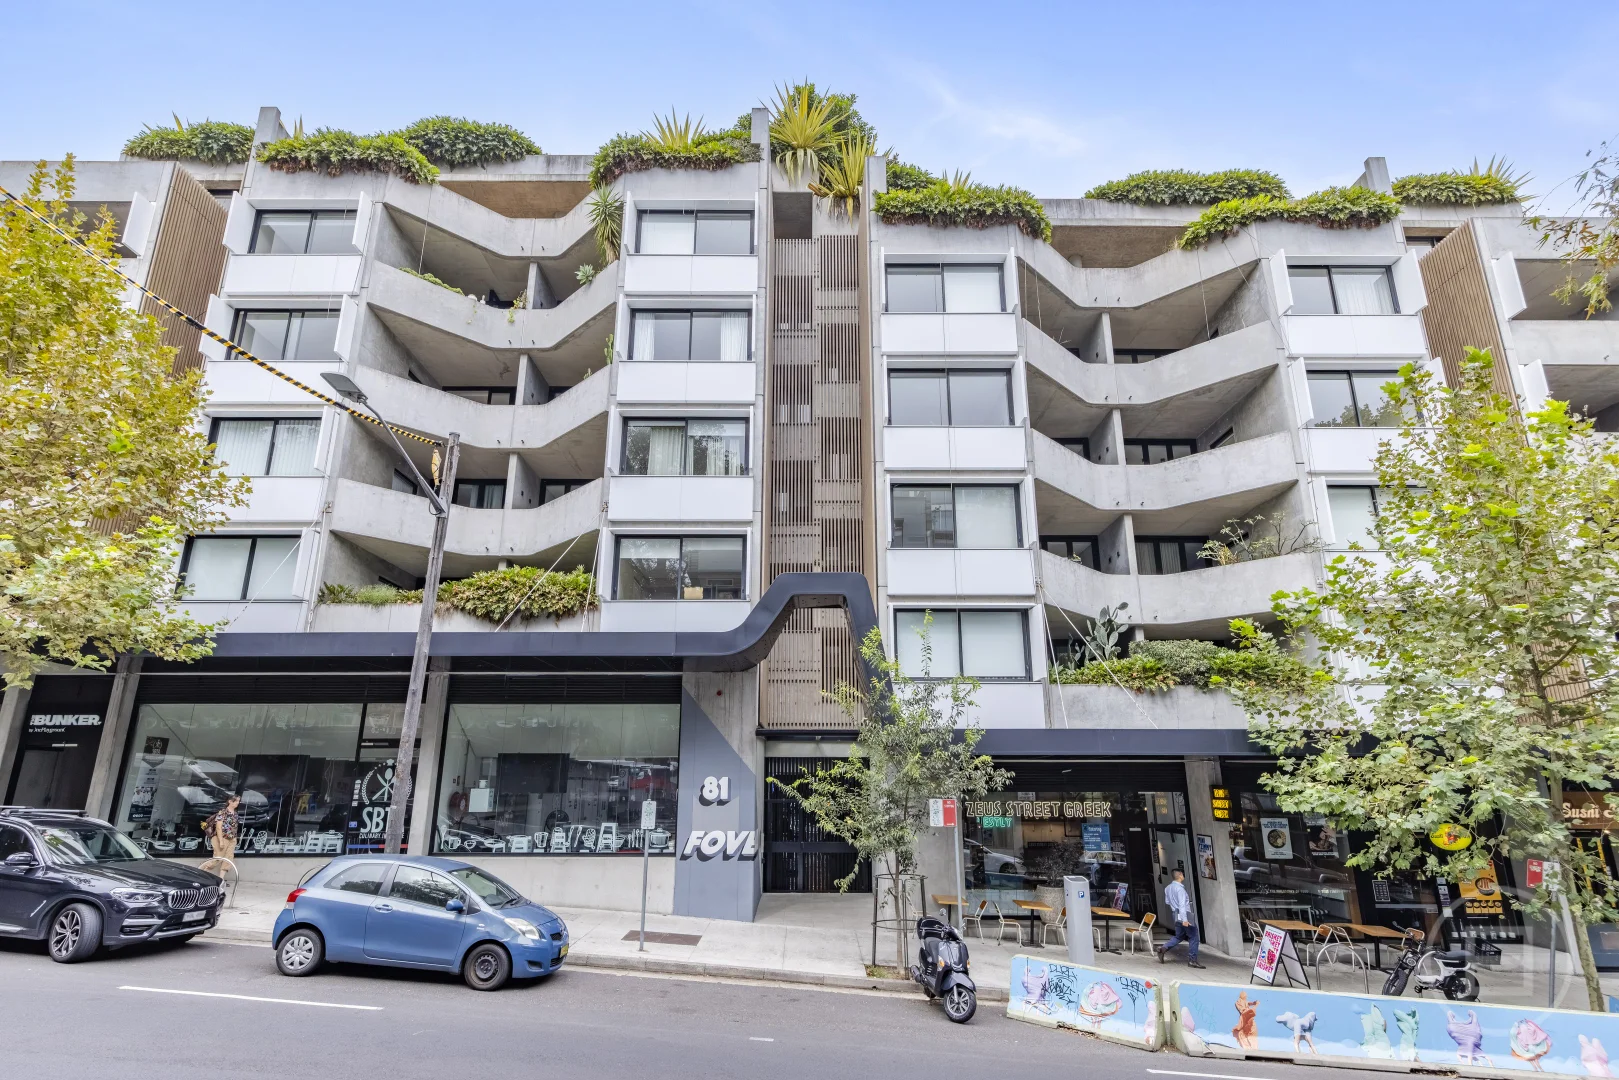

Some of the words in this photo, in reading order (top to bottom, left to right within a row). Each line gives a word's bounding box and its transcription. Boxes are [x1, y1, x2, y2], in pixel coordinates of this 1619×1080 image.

[35, 714, 101, 726] BUNKER
[702, 775, 731, 801] 81
[964, 801, 1002, 817] ZEUS
[1006, 801, 1060, 817] STREET
[1063, 801, 1112, 817] GREEK
